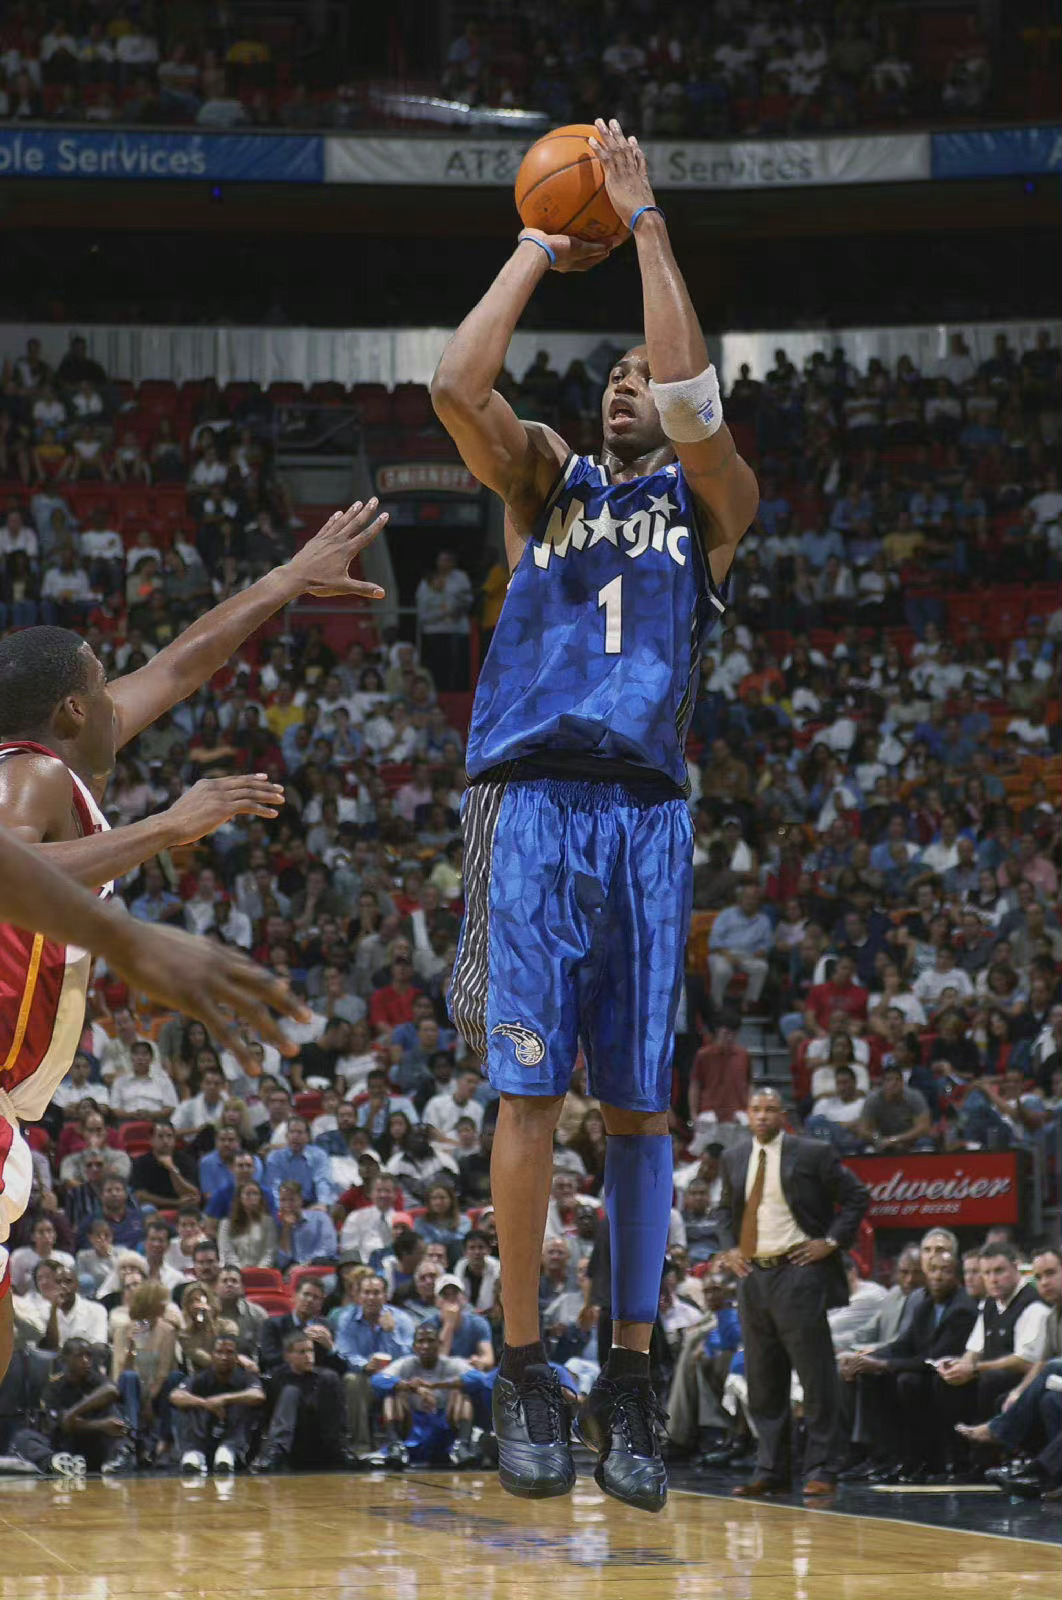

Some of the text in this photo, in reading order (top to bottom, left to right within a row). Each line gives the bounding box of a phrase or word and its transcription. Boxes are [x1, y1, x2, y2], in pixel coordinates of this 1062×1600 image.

[57, 138, 207, 174] Services
[444, 149, 524, 179] AT&
[669, 150, 814, 182] Services
[598, 574, 623, 655] 1
[866, 1168, 1011, 1201] dweiser
